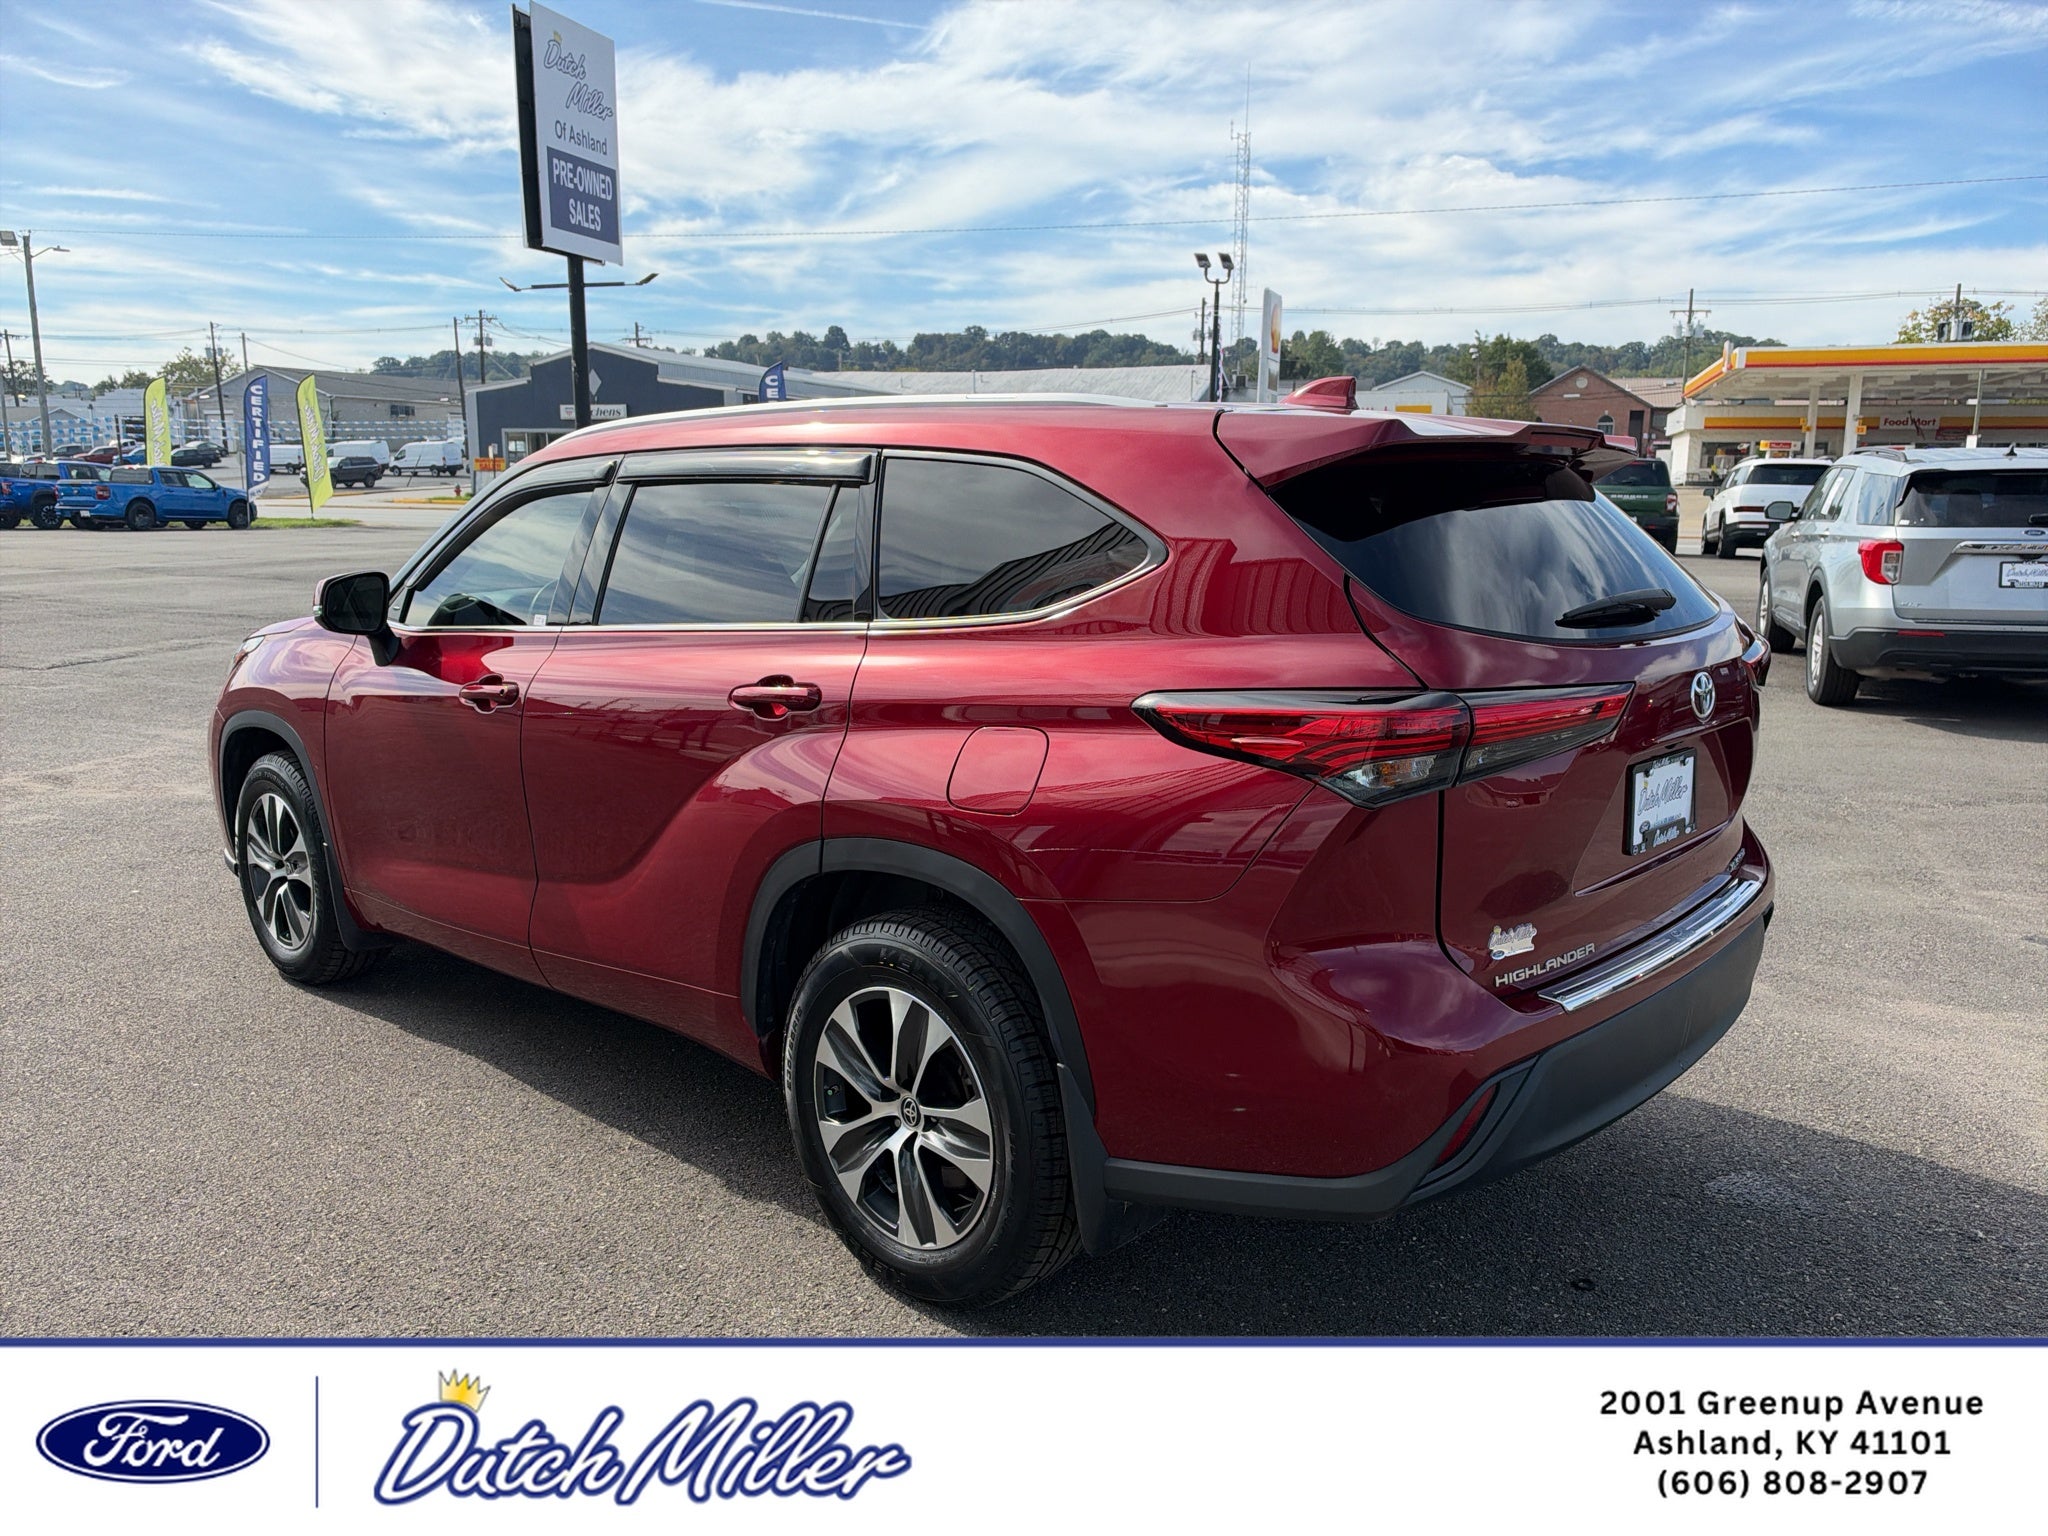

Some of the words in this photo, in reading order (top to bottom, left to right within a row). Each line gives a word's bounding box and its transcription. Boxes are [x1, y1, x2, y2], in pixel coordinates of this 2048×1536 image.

[544, 39, 586, 80] Dutch
[566, 81, 613, 121] Miller
[555, 120, 566, 140] Of
[569, 125, 607, 155] Ashland
[552, 157, 613, 201] PRE-OWNED
[568, 198, 601, 232] SALES
[250, 385, 265, 482] CERTIFIED
[1883, 417, 1909, 426] Food
[1911, 417, 1937, 426] Mart
[1495, 942, 1596, 987] HIGHLANDER
